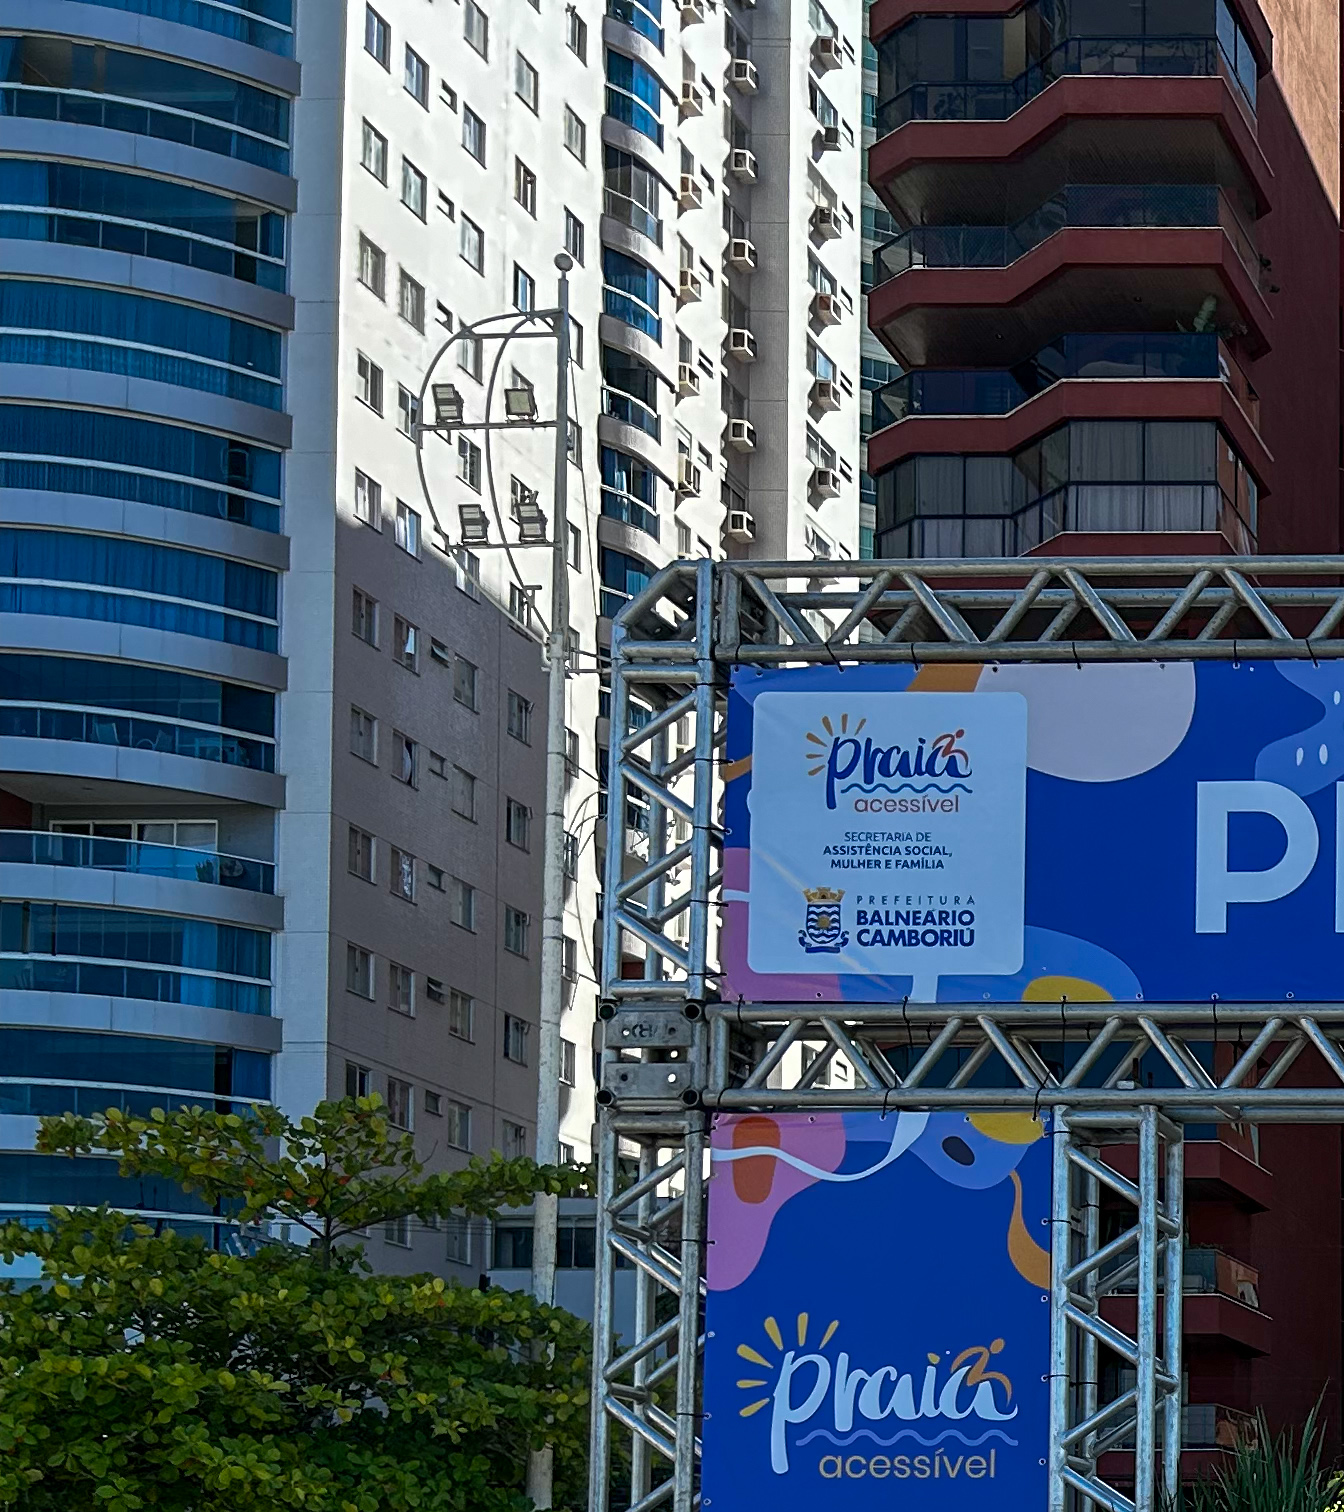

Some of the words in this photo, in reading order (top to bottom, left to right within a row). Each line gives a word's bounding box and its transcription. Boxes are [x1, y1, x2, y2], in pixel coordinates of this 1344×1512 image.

[825, 733, 973, 811] praia
[853, 793, 960, 814] acessível
[843, 831, 913, 843] SECRETARIA
[915, 831, 932, 843] DE
[822, 843, 902, 856] ASSISTÊNCIA
[904, 845, 953, 858] SOCIAL,
[830, 858, 882, 870] MULHER
[884, 858, 892, 870] E
[895, 856, 945, 870] FAMÍLIA
[856, 894, 976, 906] PREFEITURA
[856, 908, 975, 926] BALNEÁRIO
[856, 927, 975, 948] CAMBORIÚ
[770, 1350, 1019, 1475] praia
[818, 1447, 996, 1479] acessível
